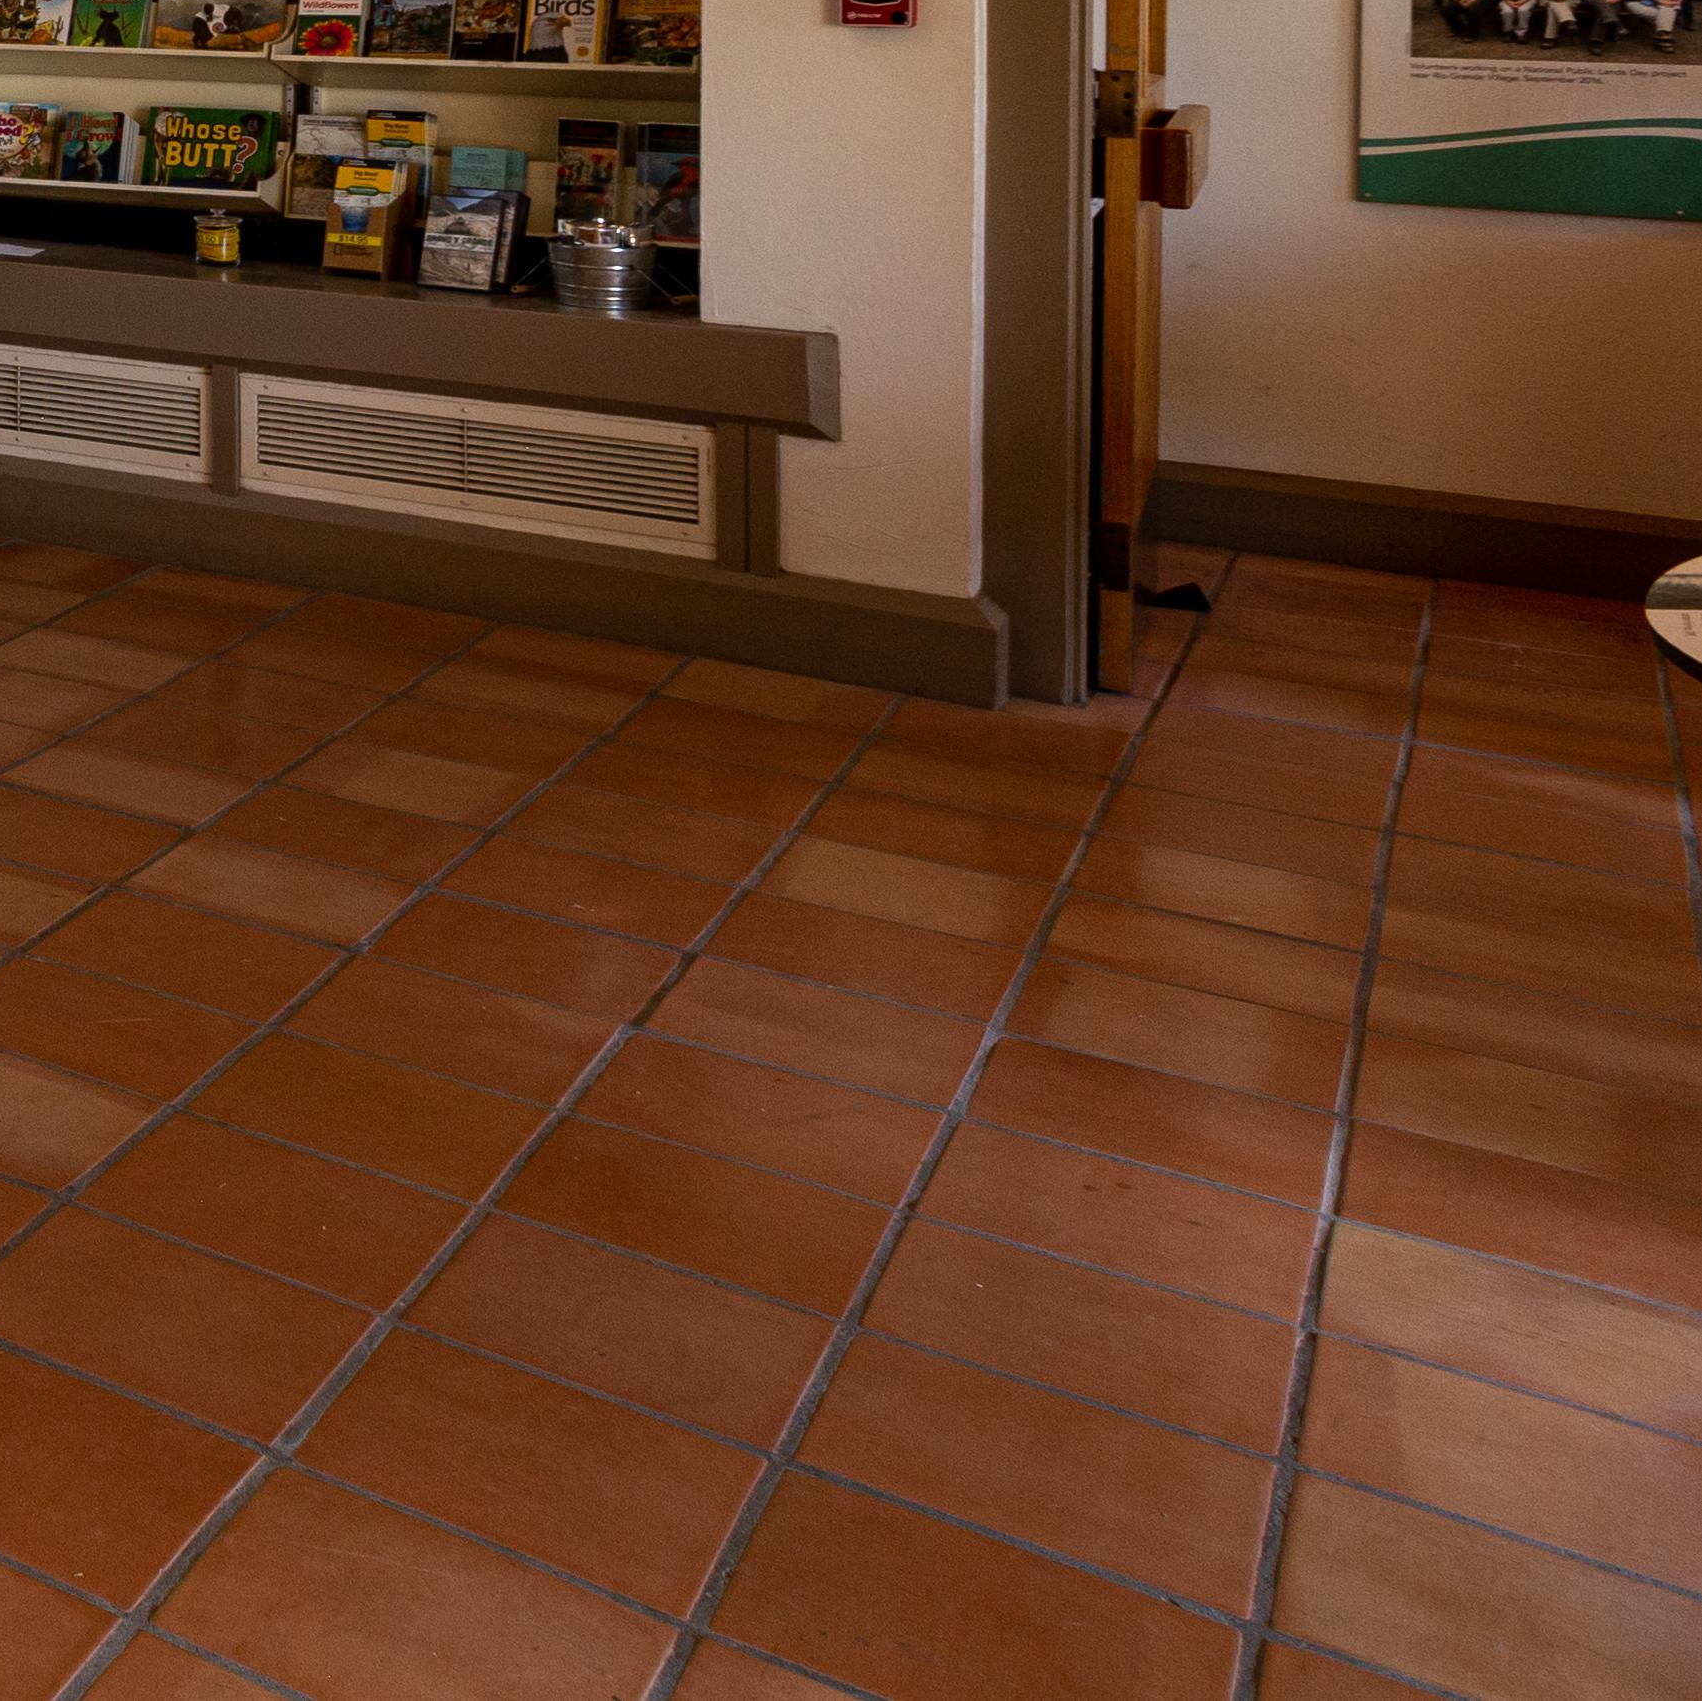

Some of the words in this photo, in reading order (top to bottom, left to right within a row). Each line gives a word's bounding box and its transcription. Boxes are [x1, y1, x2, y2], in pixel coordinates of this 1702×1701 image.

[303, 1, 359, 9] Wildflowers
[166, 115, 242, 141] Whose
[338, 233, 368, 245] $14.95
